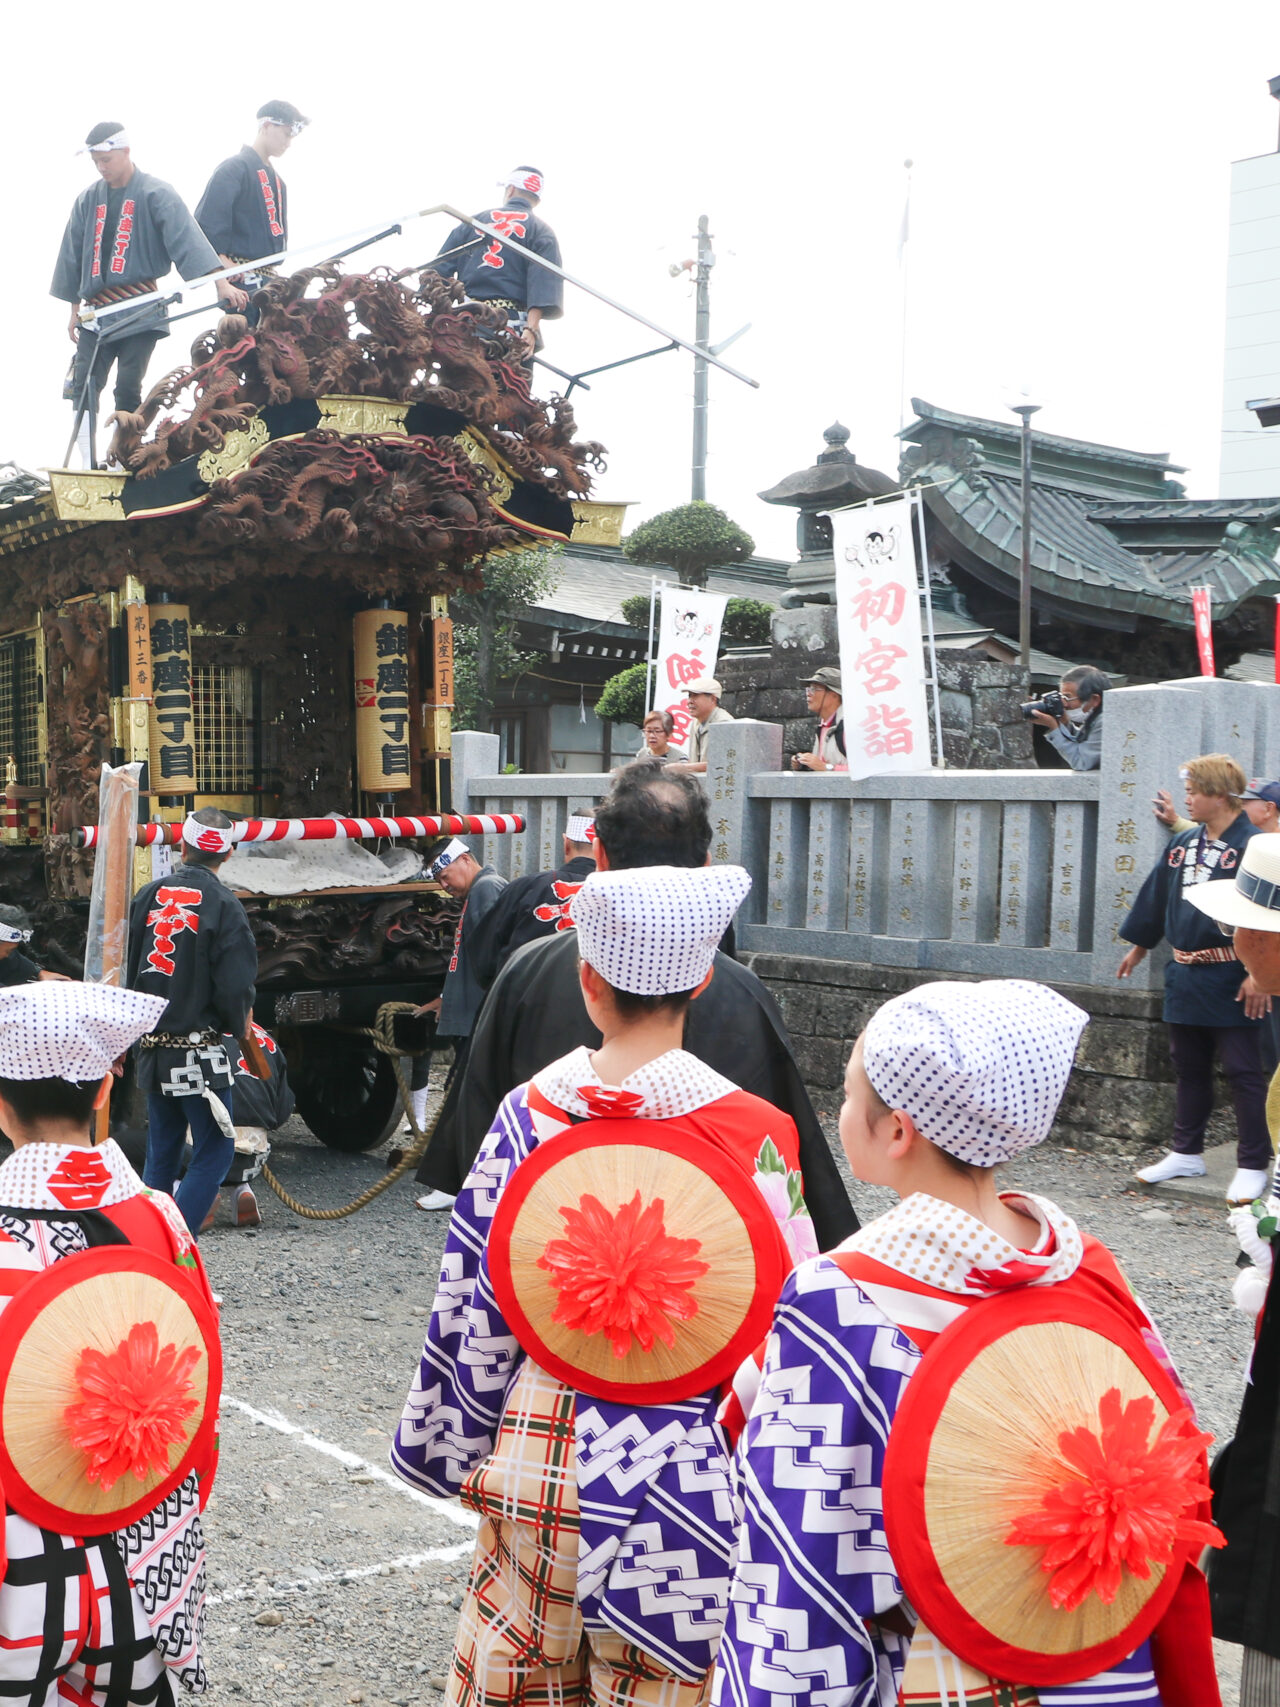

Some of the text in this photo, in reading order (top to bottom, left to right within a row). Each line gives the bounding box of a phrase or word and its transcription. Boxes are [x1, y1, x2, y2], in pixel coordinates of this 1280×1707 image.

[134, 615, 148, 686] 第十三番
[150, 618, 194, 779] 銀座一丁目
[376, 622, 410, 776] 銀座一丁目
[437, 631, 451, 698] 銀座一丁目
[850, 577, 914, 758] 初宮詣
